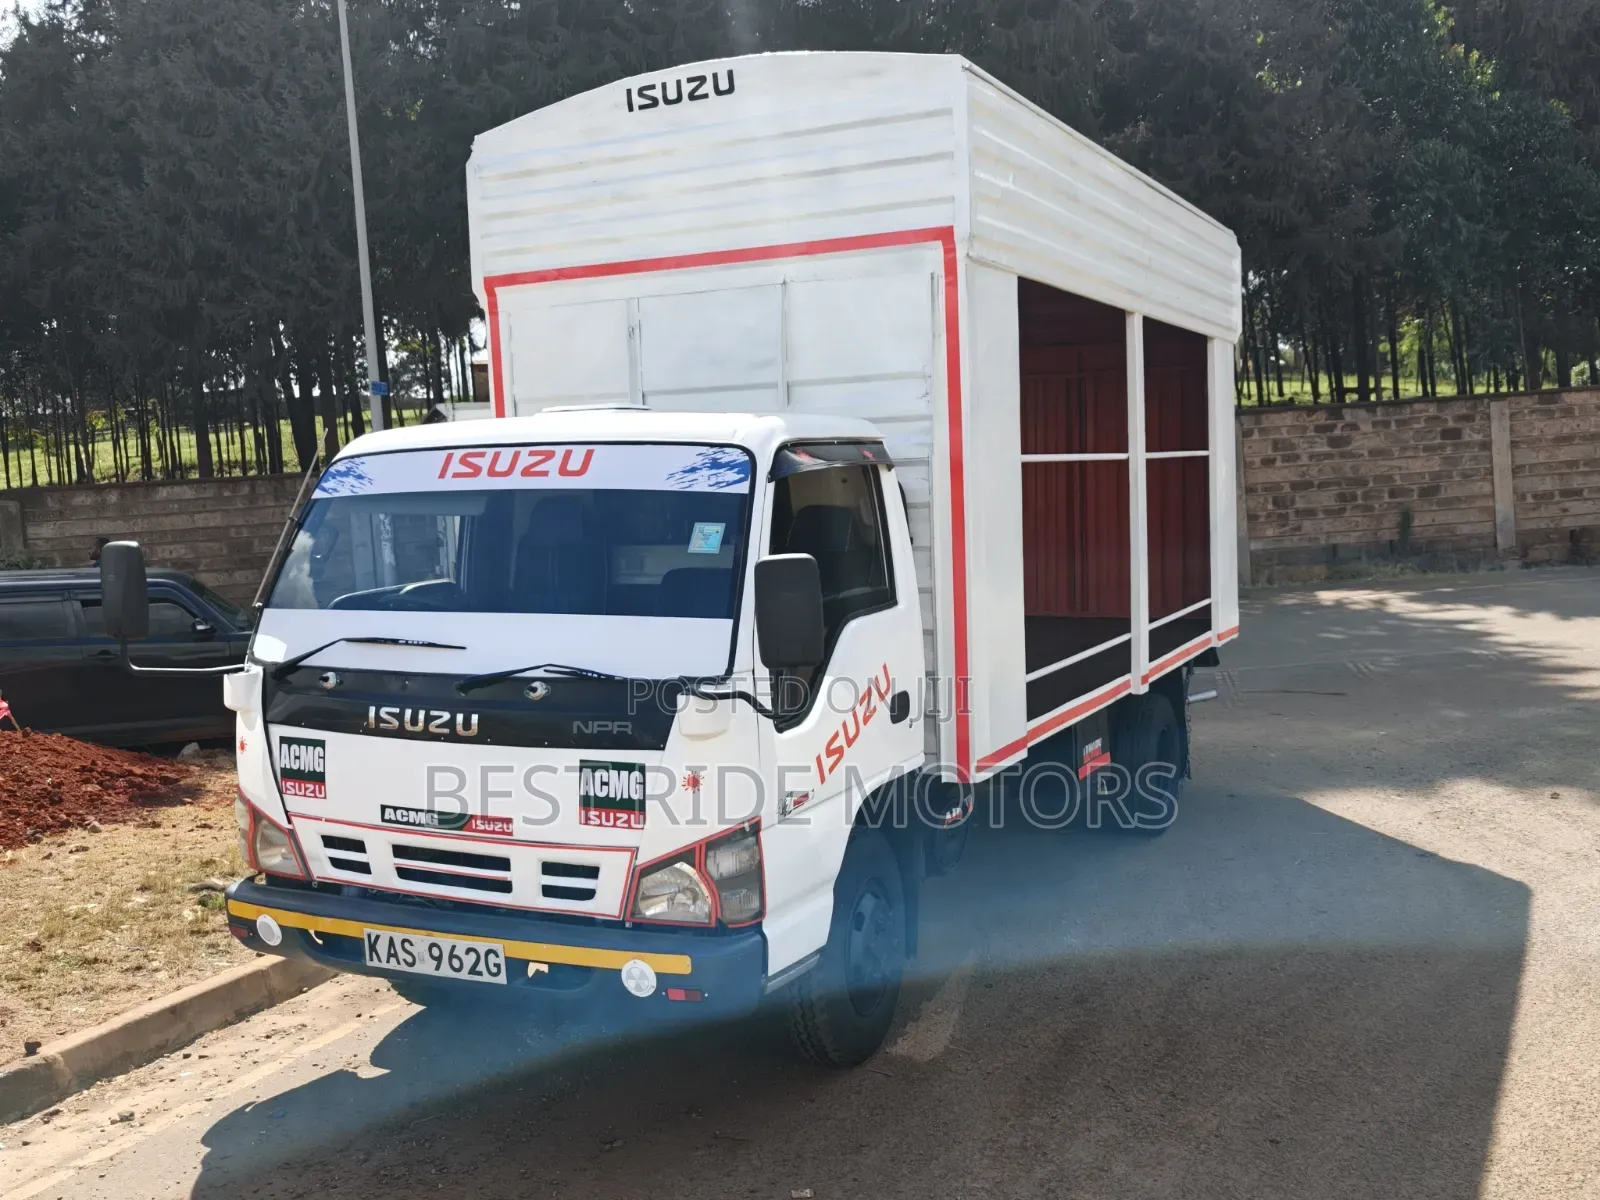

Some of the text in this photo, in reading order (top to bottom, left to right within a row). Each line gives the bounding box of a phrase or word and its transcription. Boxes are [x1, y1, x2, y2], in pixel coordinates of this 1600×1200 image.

[626, 69, 735, 112] ISUZU
[438, 449, 595, 479] ISUZU
[368, 705, 479, 737] ISUZU
[573, 721, 632, 735] NPR
[815, 662, 891, 785] ISUZU
[281, 743, 325, 773] ACMG
[282, 780, 325, 798] ISUZU
[580, 768, 644, 801] ACMG
[384, 808, 513, 833] ACMG ISUZU
[581, 810, 644, 828] ISUZU
[367, 933, 501, 978] KAS 962G
